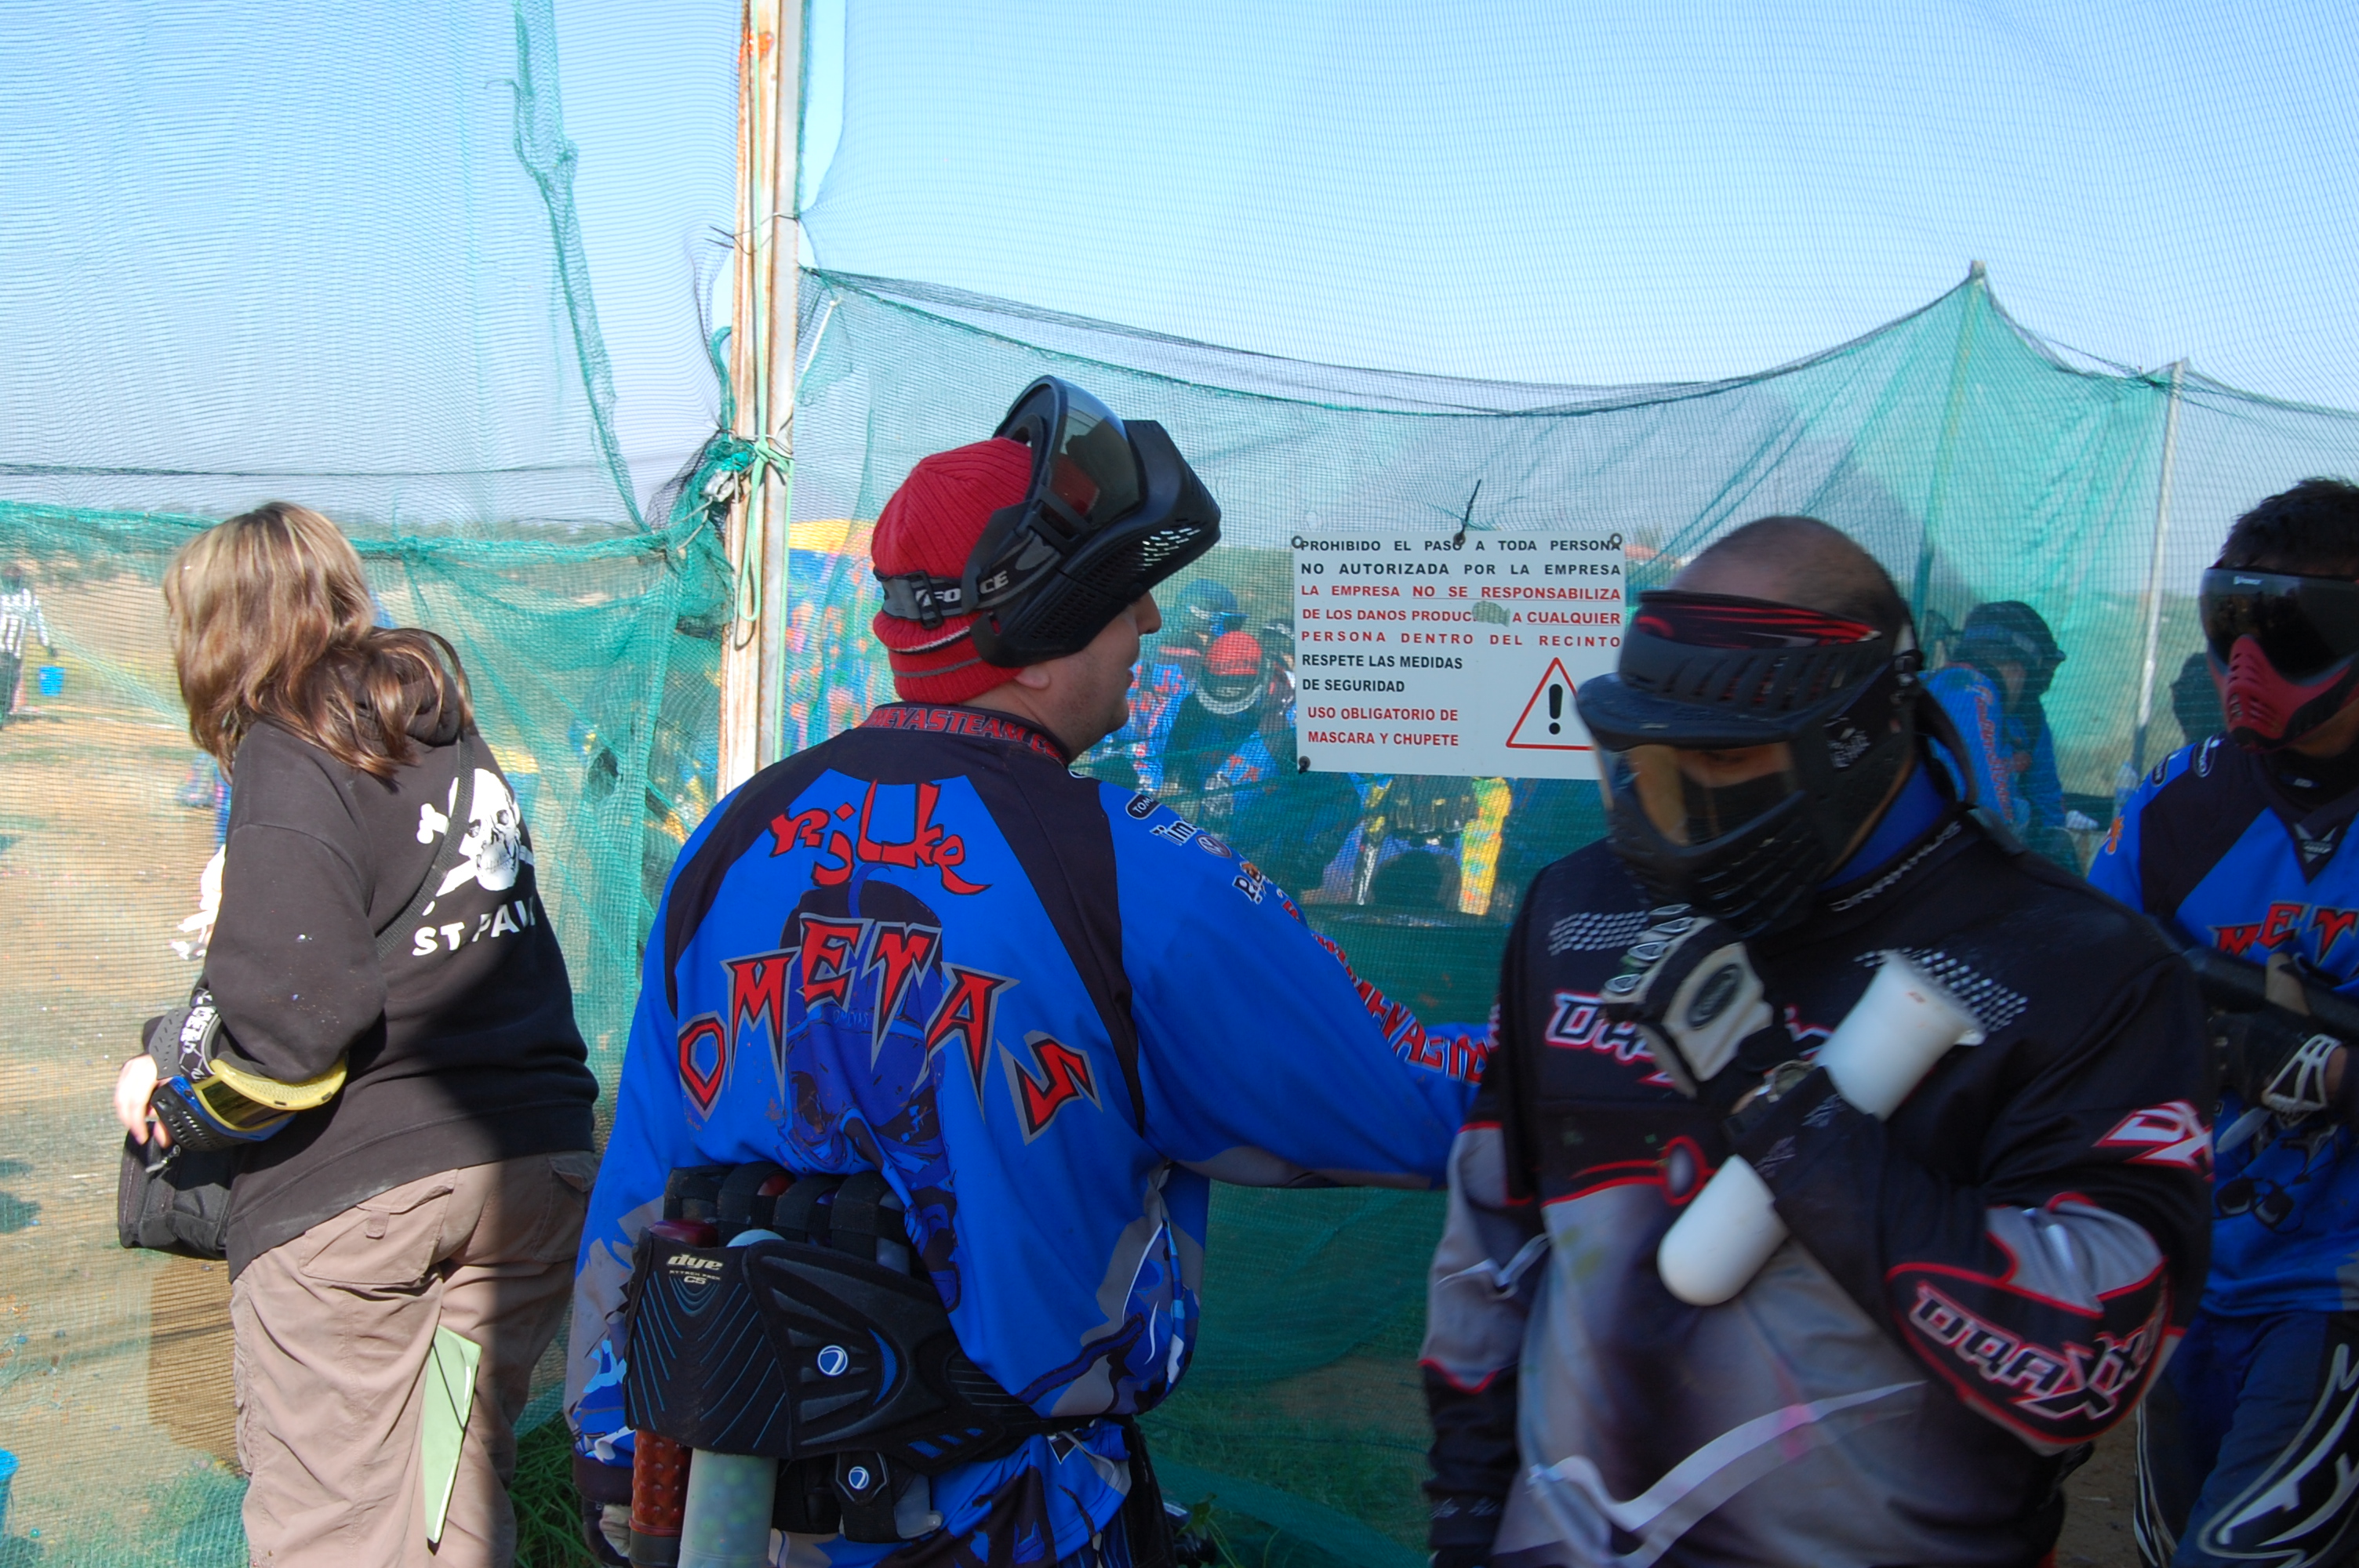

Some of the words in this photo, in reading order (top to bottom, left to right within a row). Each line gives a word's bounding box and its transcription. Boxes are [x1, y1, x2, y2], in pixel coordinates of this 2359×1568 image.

[1301, 540, 1381, 551] PROHIBIDO
[1394, 540, 1412, 551] EL
[1424, 540, 1463, 551] PASO
[1475, 540, 1485, 550] A
[1498, 540, 1537, 551] TODA
[1550, 540, 1621, 551] PERSONA
[1301, 563, 1325, 575] NO
[1339, 563, 1449, 575] AUTORIZADA
[1464, 564, 1496, 575] POR
[1510, 564, 1530, 575] LA
[1545, 564, 1621, 575] EMPRESA
[1301, 586, 1319, 596] LA
[1332, 586, 1400, 597] EMPRESA
[1412, 586, 1435, 597] NO
[1448, 586, 1468, 597] SE
[1481, 587, 1621, 600] RESPONSABILIZA
[1303, 609, 1321, 619] DE
[1326, 609, 1353, 620] LOS
[1358, 610, 1407, 621] DANOS
[1412, 610, 1478, 622] PRODUC
[1513, 612, 1522, 622] A
[1527, 612, 1621, 625] CUALQUIER
[1301, 631, 1387, 642] PERSONA
[1401, 633, 1474, 644] DENTRO
[1490, 634, 1523, 645] DEL
[1539, 635, 1621, 648] RECINTO
[1302, 654, 1365, 666] RESPETE
[1369, 655, 1395, 667] LAS
[1400, 656, 1463, 670] MEDIDAS
[1303, 679, 1320, 690] DE
[1325, 680, 1405, 692] SEGURIDAD
[1307, 707, 1336, 719] USO
[1341, 708, 1436, 720] OBLIGATORIO
[1440, 710, 1459, 720] DE
[1308, 731, 1376, 744] MASCARA
[1379, 733, 1389, 744] Y
[1393, 733, 1459, 746] CHUPETE
[412, 922, 465, 956] ST
[678, 912, 1103, 1146] OMEYAS
[667, 1254, 723, 1270] dye
